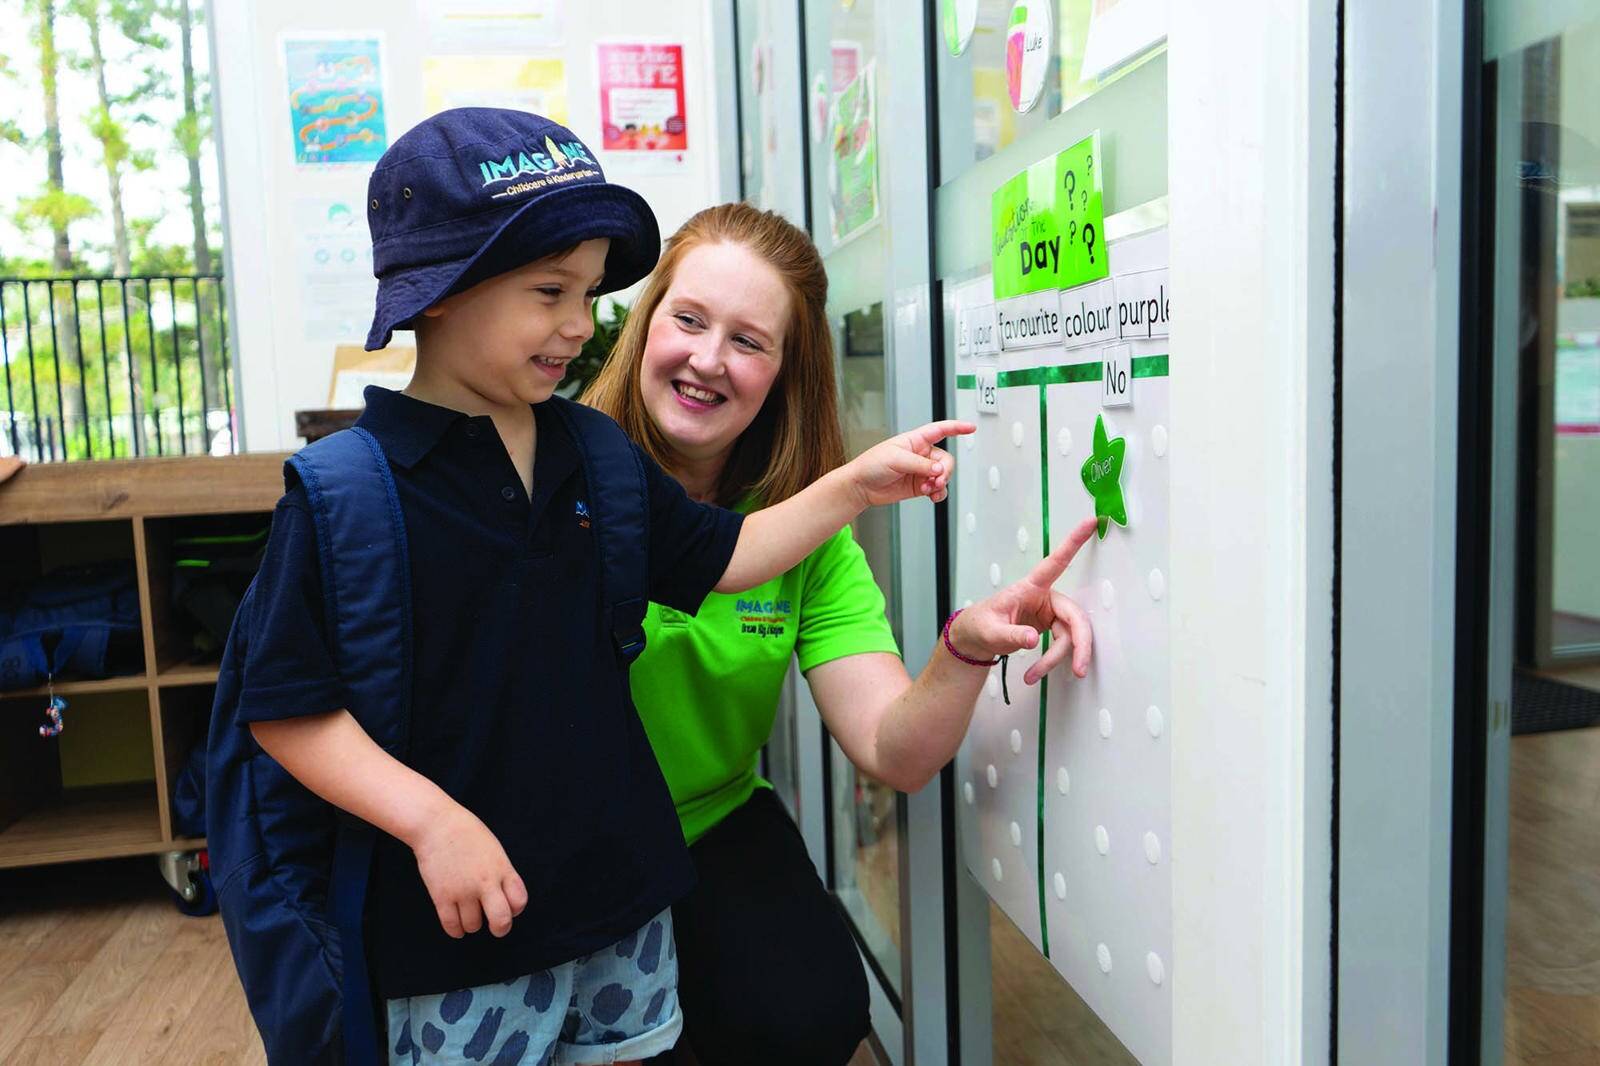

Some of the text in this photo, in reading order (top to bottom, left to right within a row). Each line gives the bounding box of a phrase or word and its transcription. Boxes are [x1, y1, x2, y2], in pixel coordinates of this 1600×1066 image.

[1026, 32, 1043, 52] Luke
[506, 179, 547, 195] Childcare
[1020, 235, 1060, 276] Day
[999, 308, 1059, 351] favourite
[1065, 302, 1112, 338] colour
[977, 376, 995, 405] Yes
[1106, 361, 1126, 395] No
[736, 599, 791, 614] IMAGNE
